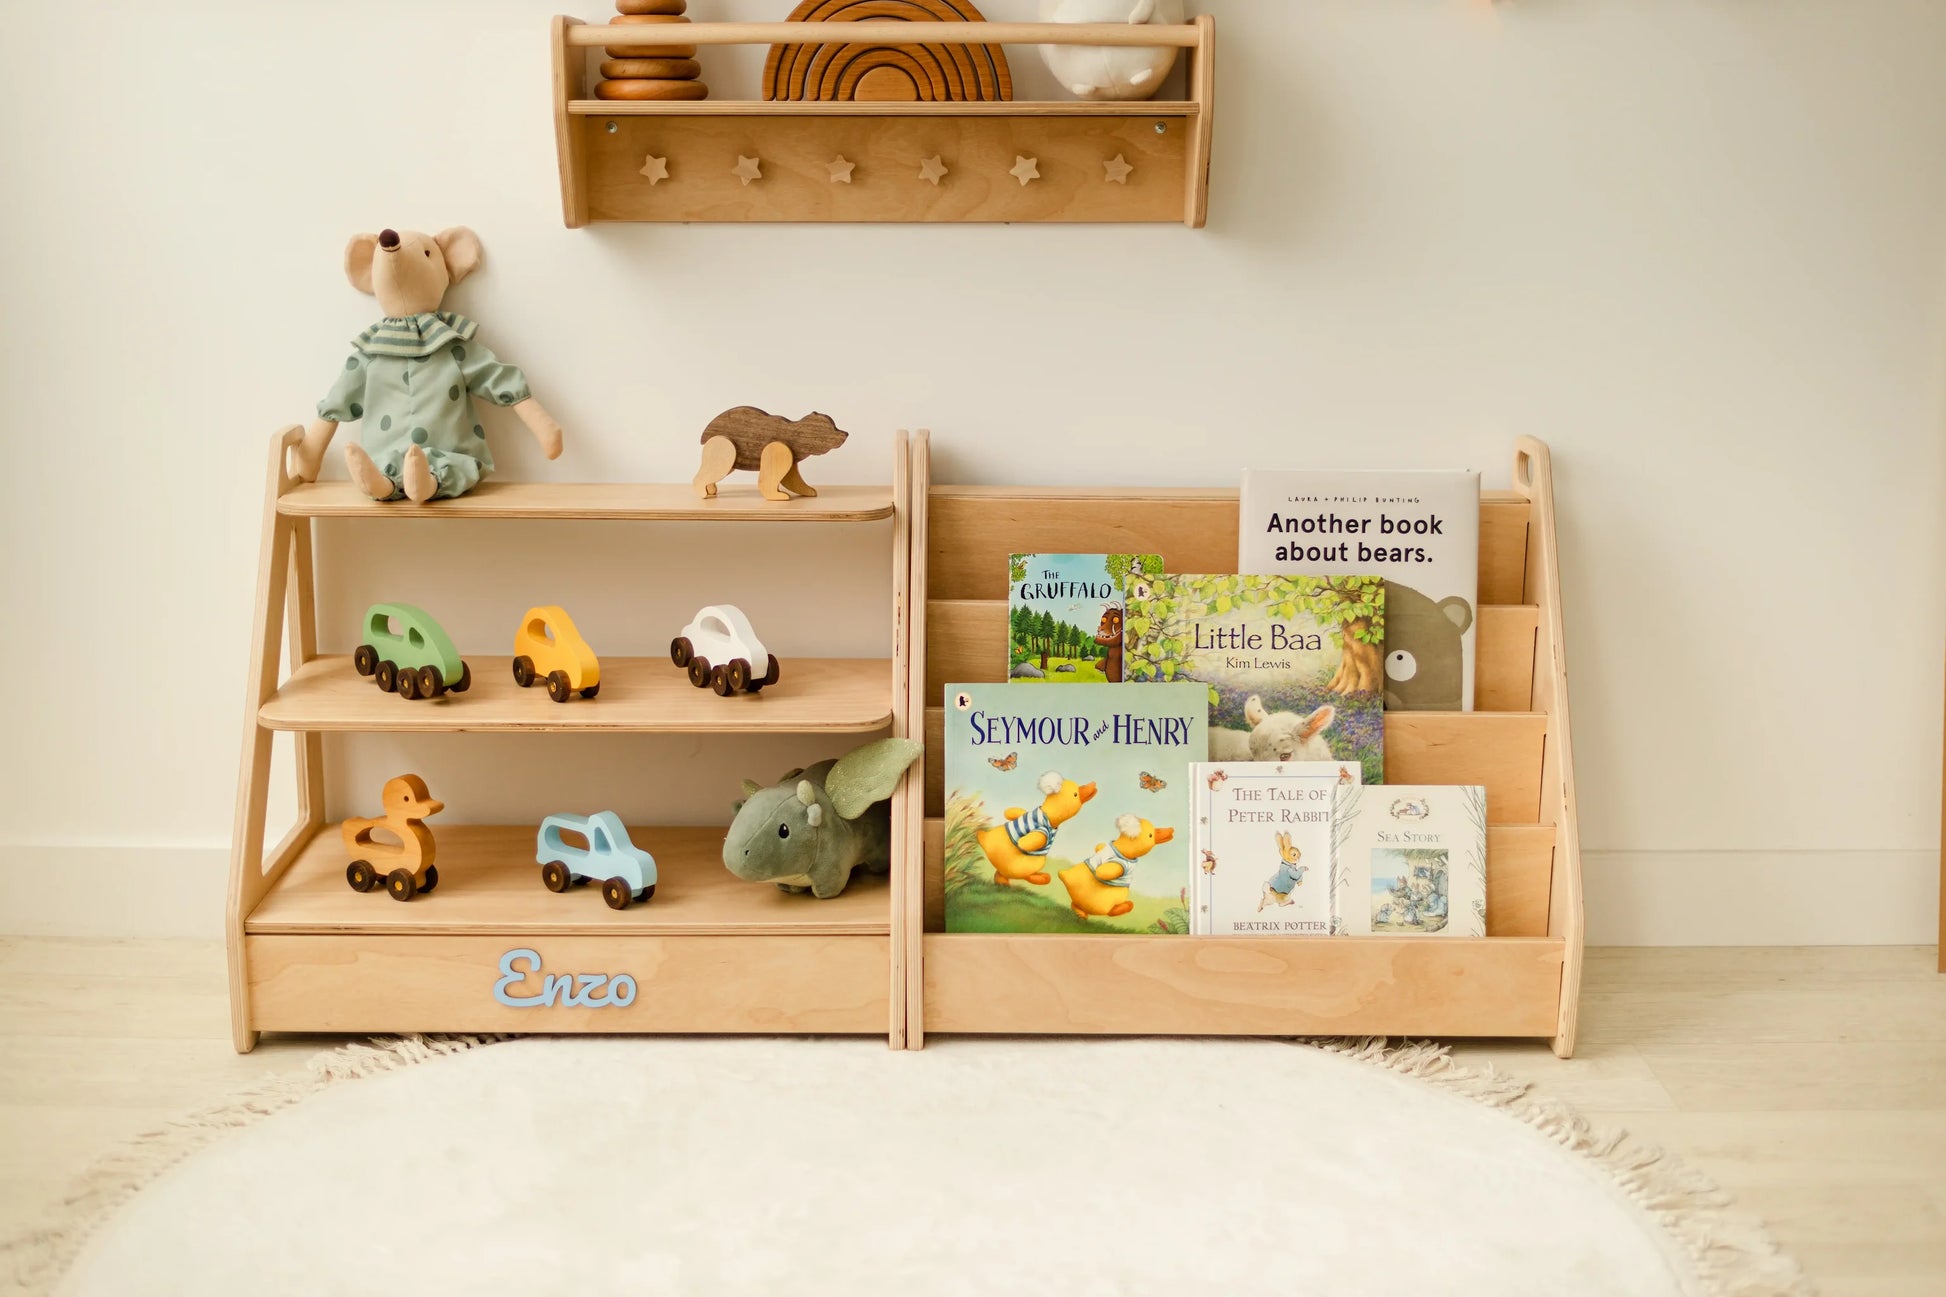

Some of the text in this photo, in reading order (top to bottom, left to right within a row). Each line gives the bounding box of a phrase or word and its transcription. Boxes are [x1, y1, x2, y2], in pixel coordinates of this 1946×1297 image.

[1266, 512, 1443, 535] Another book
[1275, 541, 1433, 563] about bears.
[1041, 569, 1060, 580] THE
[1020, 581, 1112, 600] GRUFFALO
[1194, 623, 1322, 651] Little Baa
[1226, 657, 1291, 669] Kim Lewis
[970, 710, 1194, 746] SEYMOUR and HENRY
[1232, 787, 1327, 801] THE TALE OF
[1228, 808, 1274, 823] PETER
[1377, 830, 1440, 843] SEA STORY
[1233, 921, 1327, 931] BEATRIX POTTER
[493, 947, 638, 1008] Enzo
